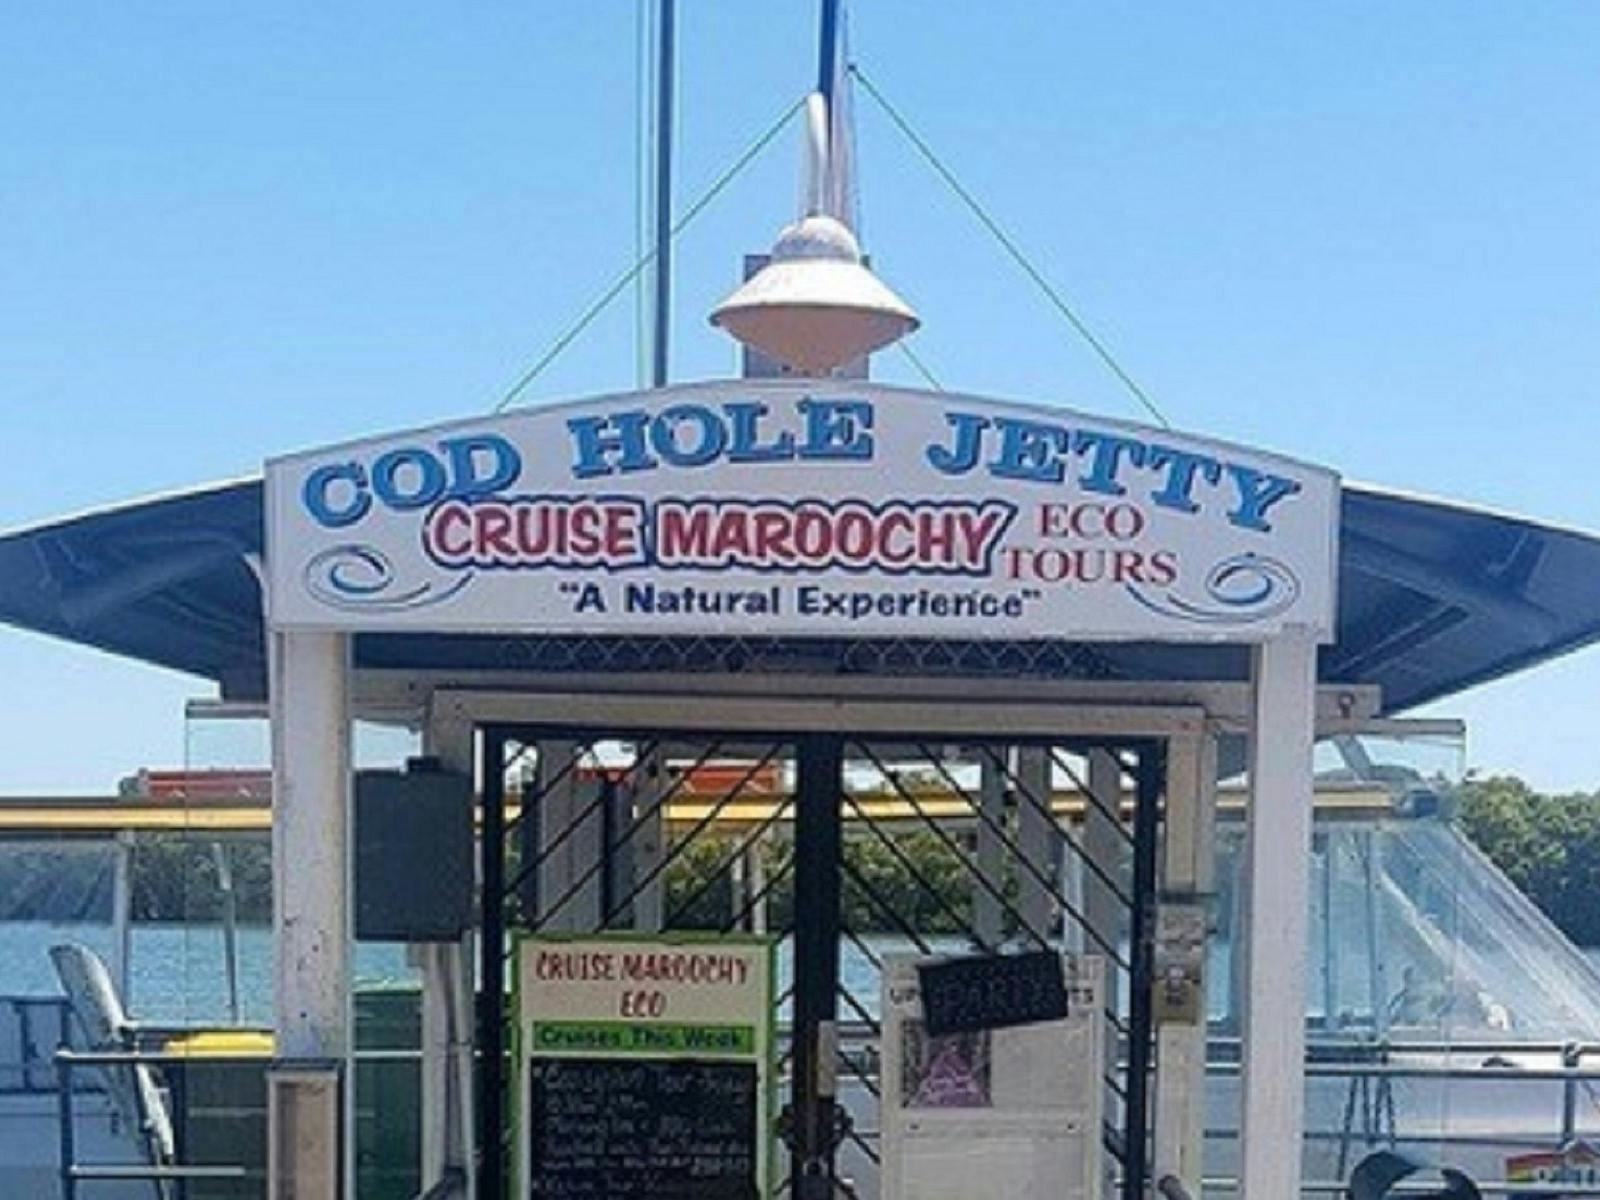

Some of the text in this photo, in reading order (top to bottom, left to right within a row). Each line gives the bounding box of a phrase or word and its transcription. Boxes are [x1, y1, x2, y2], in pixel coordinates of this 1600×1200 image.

[304, 399, 1302, 533] COD HOLE JETTY
[428, 500, 1004, 569] CRUISE MAROOCHY
[1039, 503, 1144, 539] ECO
[1003, 549, 1178, 584] TOURS
[624, 582, 781, 614] Natural
[535, 951, 748, 984] CRUISE MAROOCHY
[619, 990, 668, 1018] ECO
